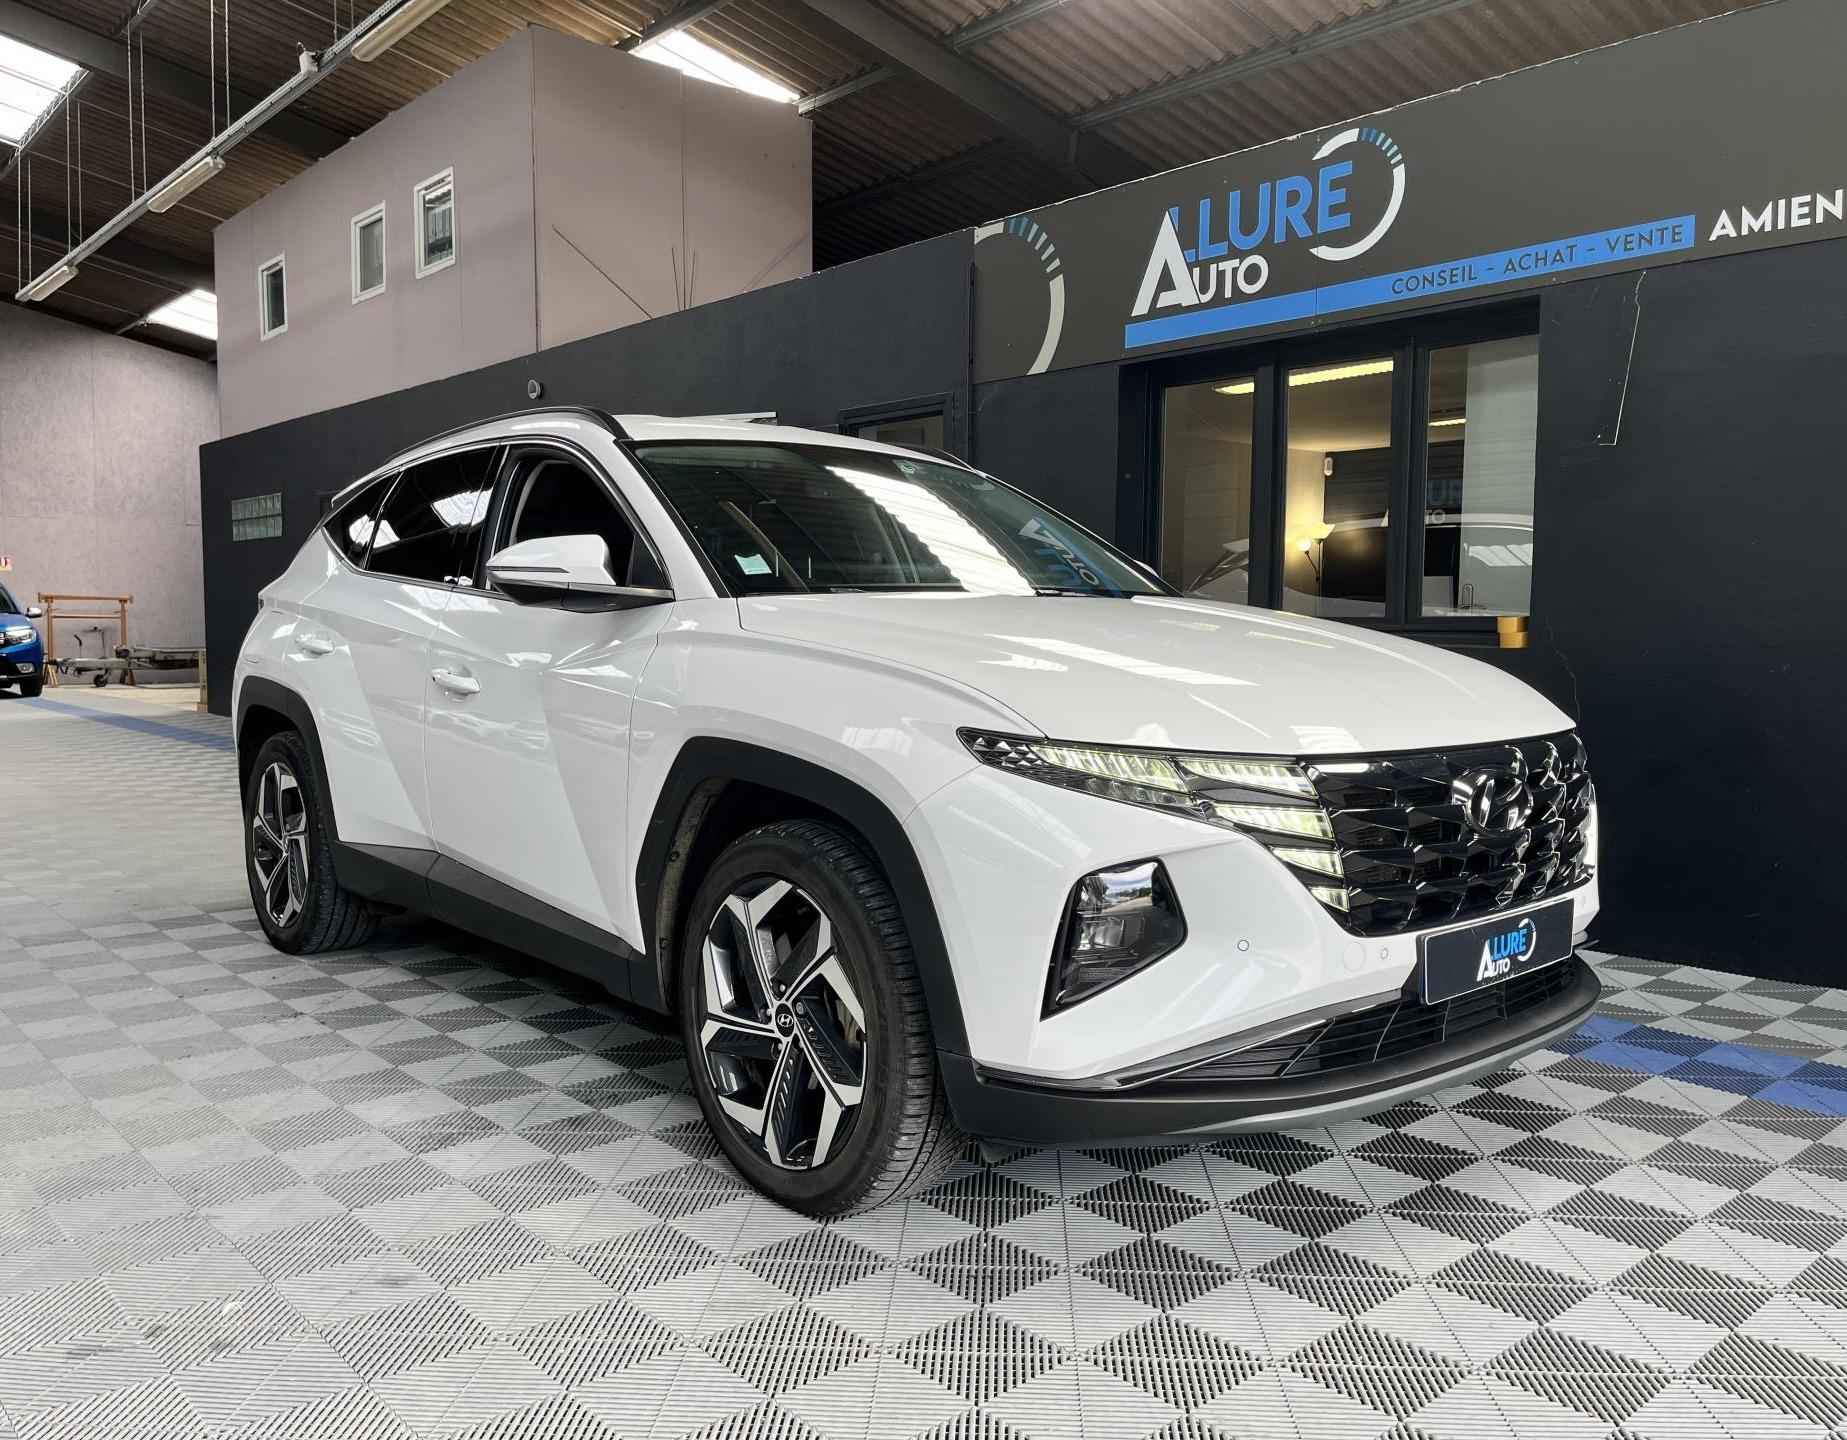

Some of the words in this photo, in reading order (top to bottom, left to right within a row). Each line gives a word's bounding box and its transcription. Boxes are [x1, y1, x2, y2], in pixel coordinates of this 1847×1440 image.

[1708, 188, 1844, 242] AMIEN
[1131, 210, 1269, 317] AUTO
[1391, 264, 1478, 295] CONSEIL
[1503, 244, 1578, 275] ACHAT
[1605, 224, 1683, 255] VENTE
[1477, 940, 1510, 981] AUTO
